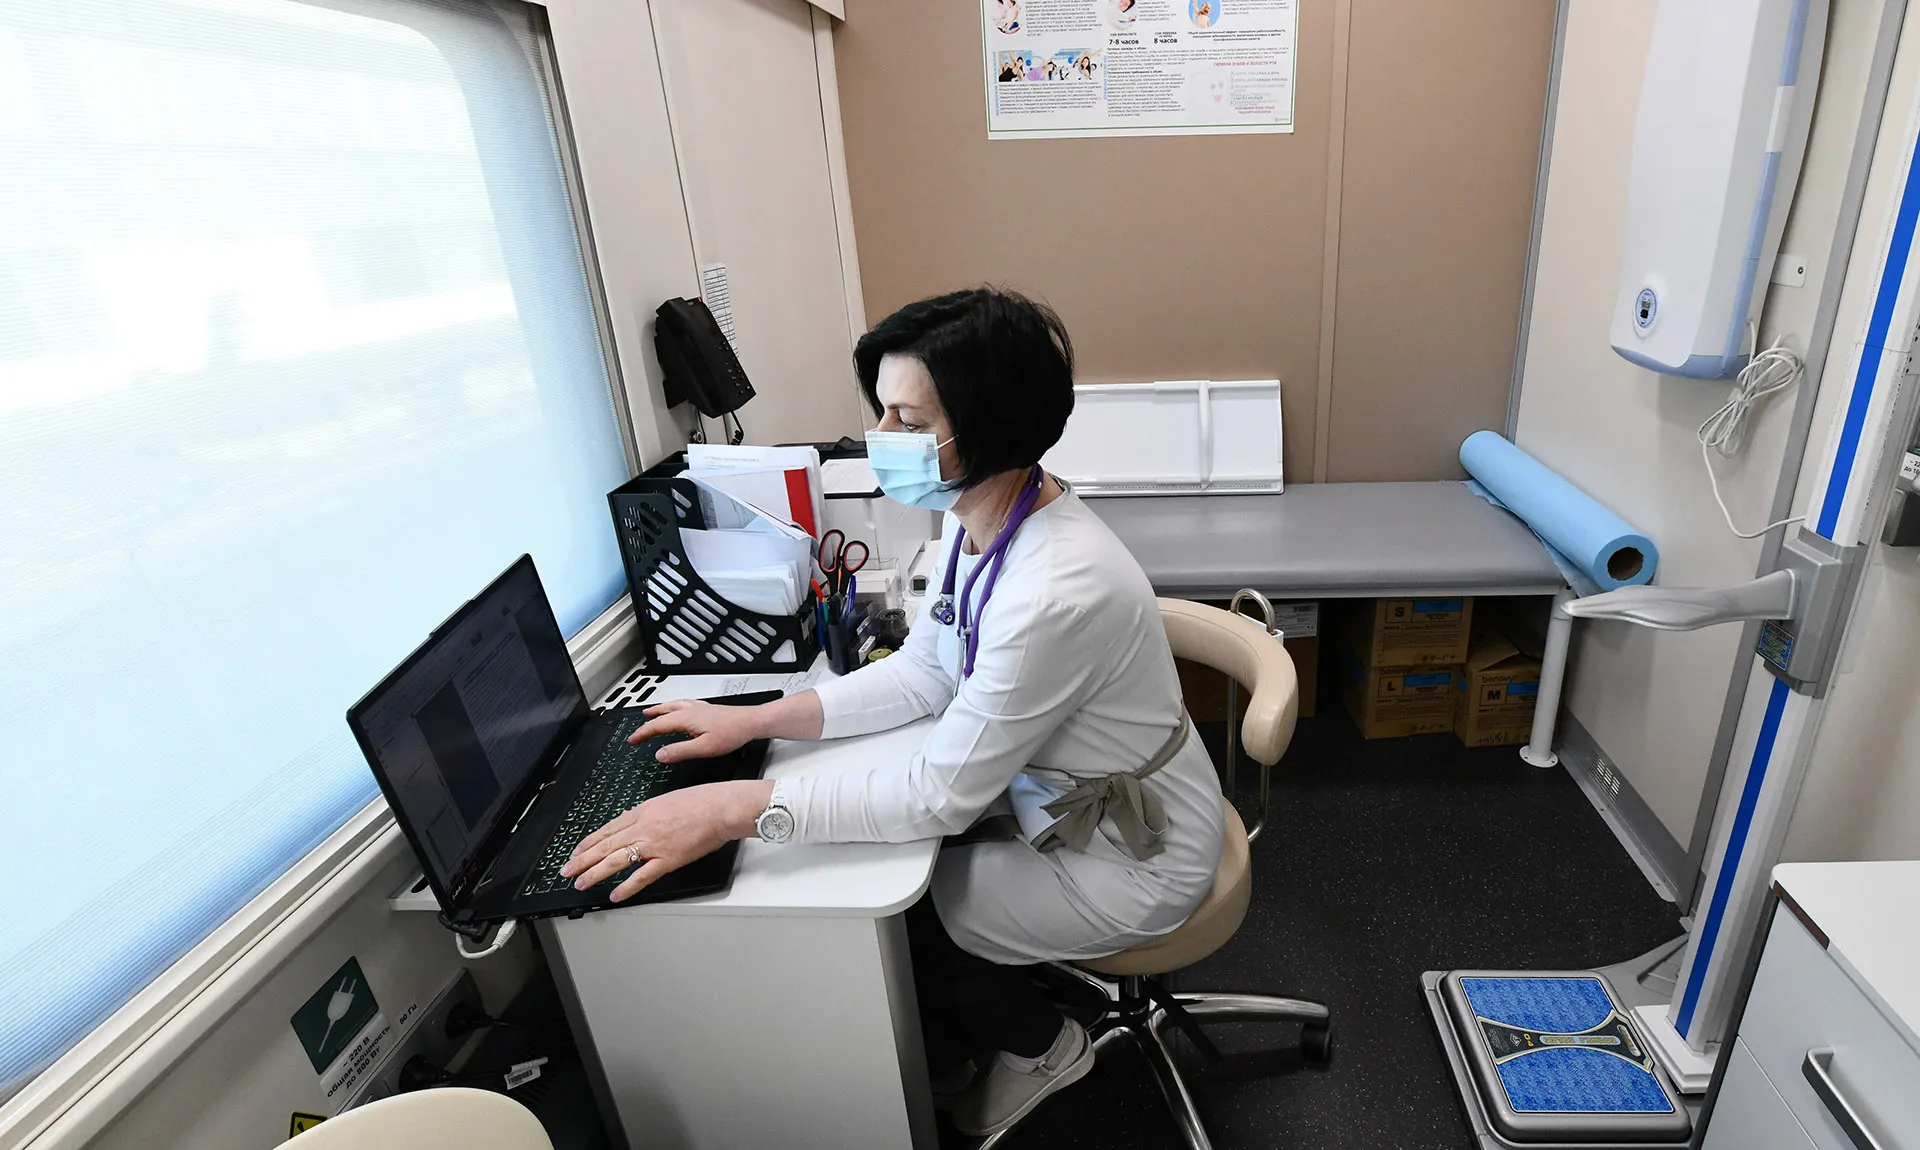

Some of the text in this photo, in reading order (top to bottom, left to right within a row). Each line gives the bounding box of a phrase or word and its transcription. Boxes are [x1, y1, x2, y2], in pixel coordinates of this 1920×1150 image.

[1394, 606, 1404, 618] S
[1387, 682, 1396, 691] L
[1487, 690, 1501, 701] M
[399, 1003, 418, 1025] 50 Гц
[348, 1044, 362, 1061] 220
[362, 1036, 370, 1045] В
[327, 1025, 391, 1098] общая мощность
[346, 1046, 381, 1089] до 800 Вт
